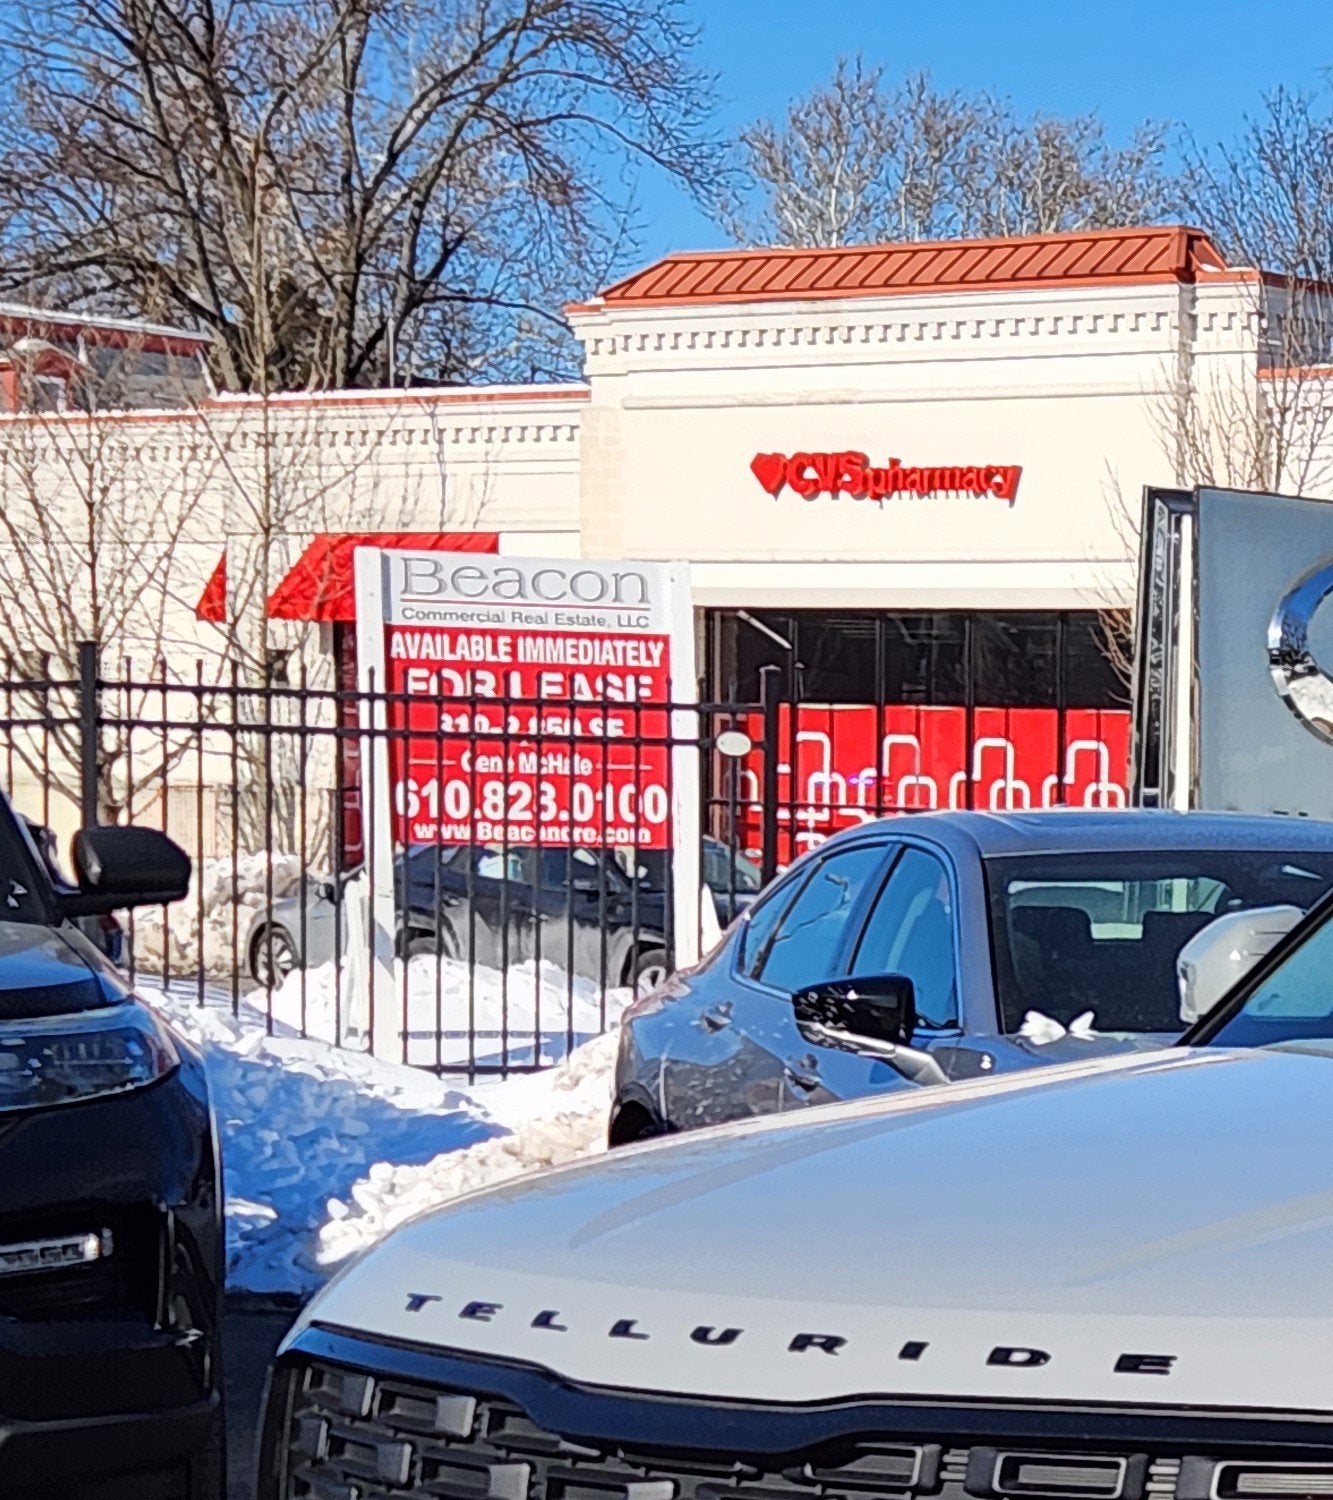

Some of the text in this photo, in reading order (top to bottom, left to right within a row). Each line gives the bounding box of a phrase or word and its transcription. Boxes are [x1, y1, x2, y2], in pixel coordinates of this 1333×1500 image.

[401, 556, 651, 603] Beacon
[401, 607, 505, 624] Commercial
[511, 610, 548, 625] Real
[617, 614, 650, 629] LLC
[391, 632, 664, 667] AVAILABLE IMMEDIATELY
[407, 667, 653, 703] FOR LEASE
[396, 778, 668, 824] 610.823.0100
[404, 1292, 1179, 1376] TELLURIDE
